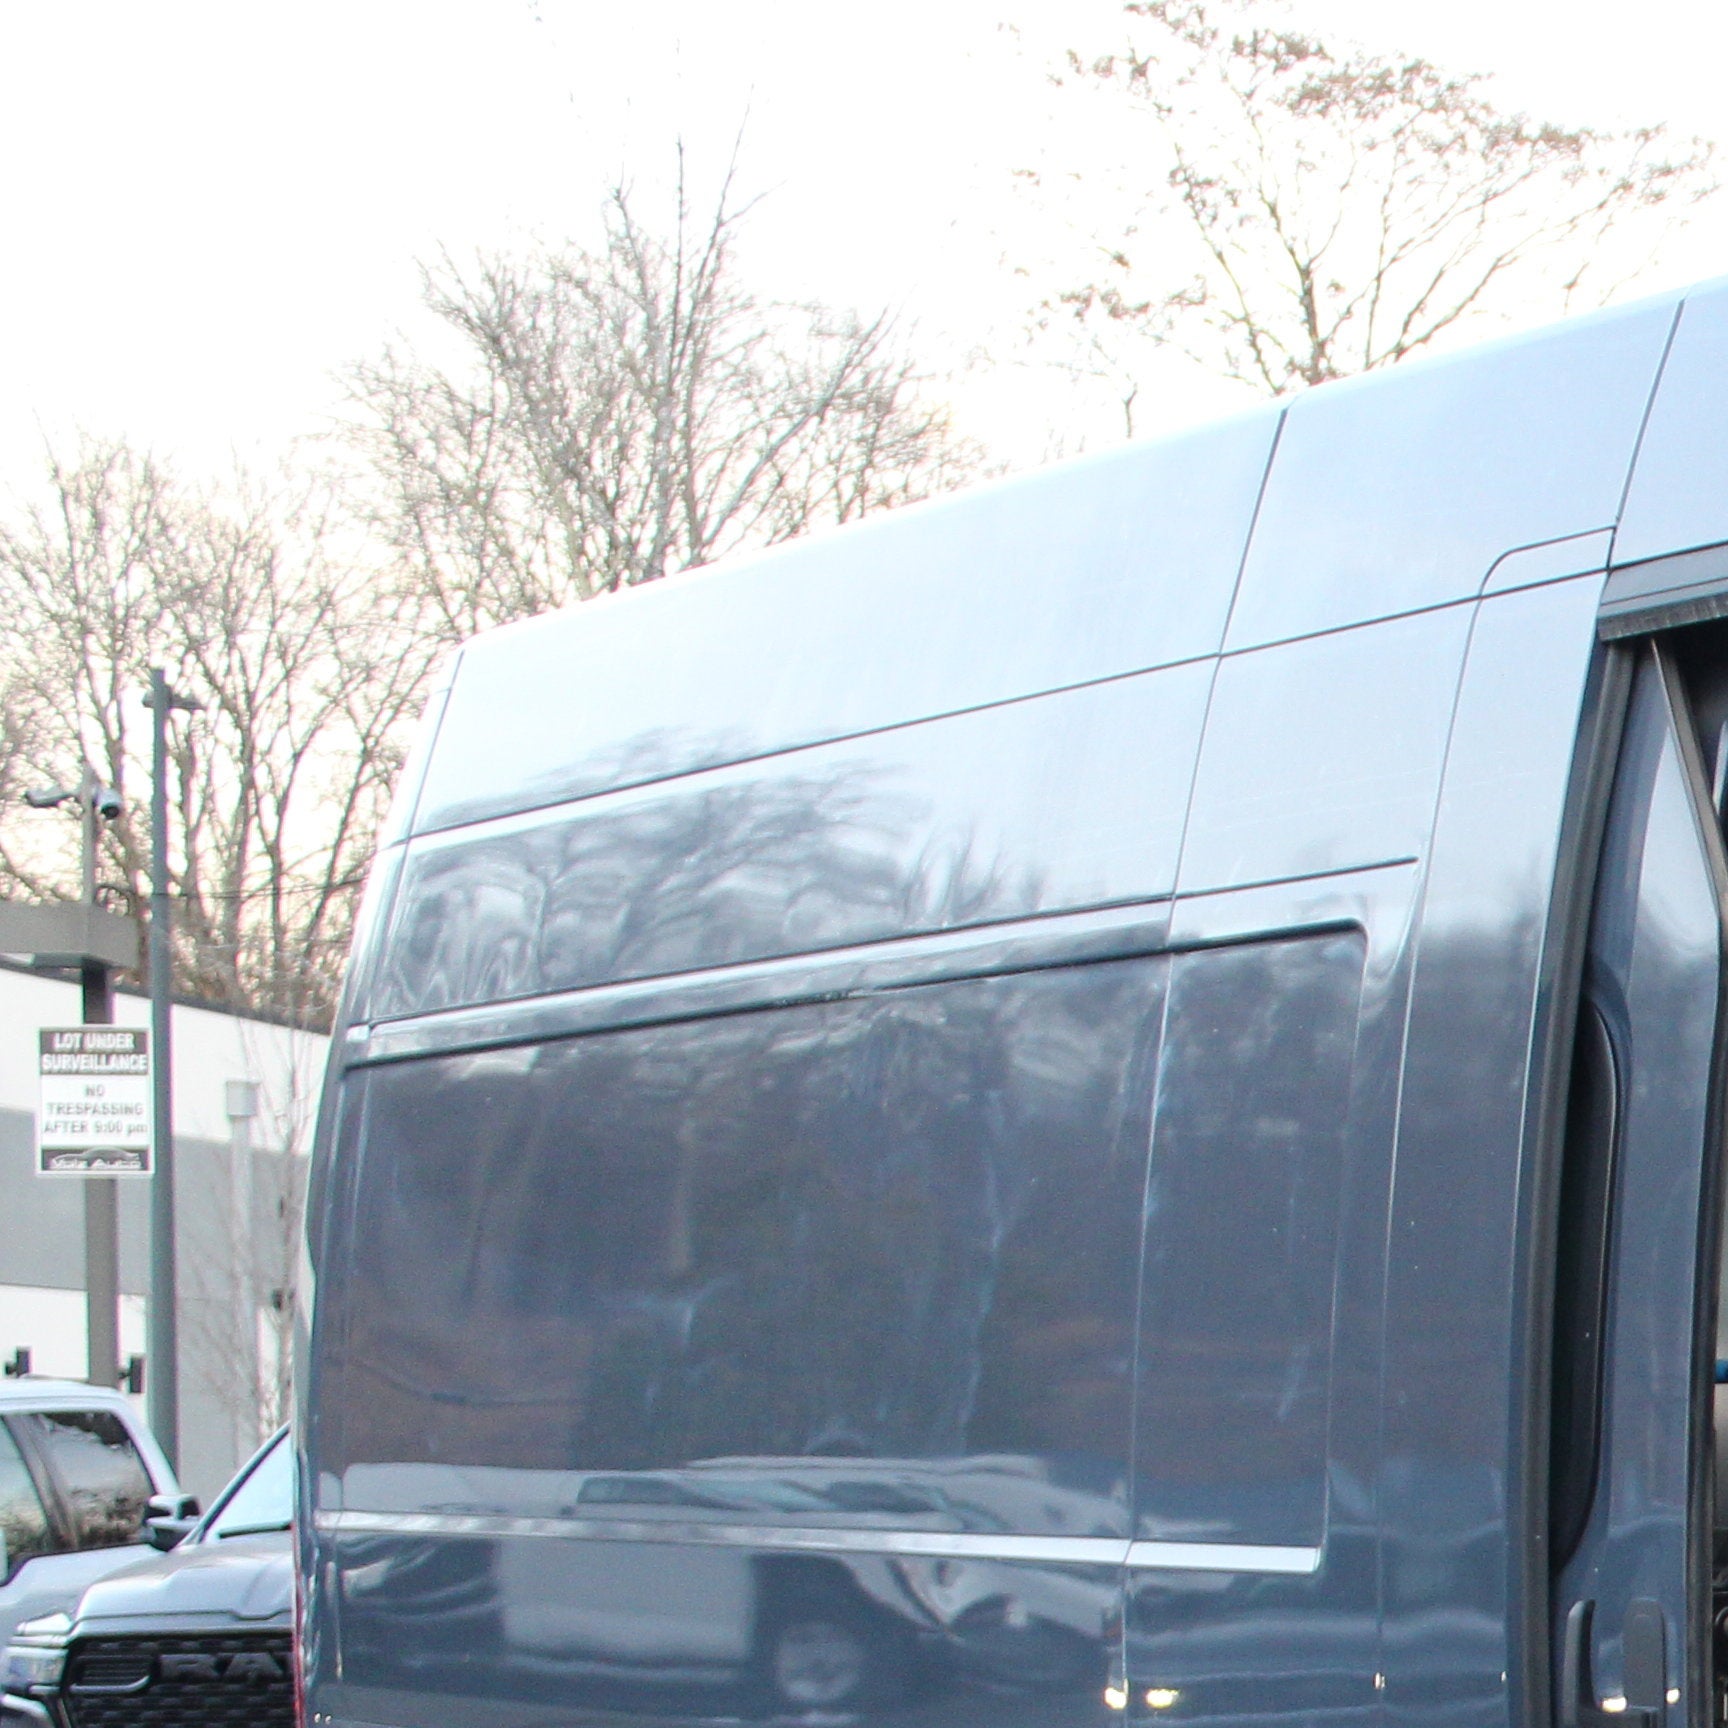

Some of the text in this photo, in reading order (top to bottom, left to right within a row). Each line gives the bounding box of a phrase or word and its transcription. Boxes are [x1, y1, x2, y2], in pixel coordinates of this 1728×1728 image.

[54, 1032, 135, 1049] LOT UNDER
[42, 1053, 147, 1071] SURVEILLANCE
[85, 1083, 105, 1098] NO
[47, 1102, 144, 1116] TRESPASSING
[44, 1120, 89, 1134] AFTER
